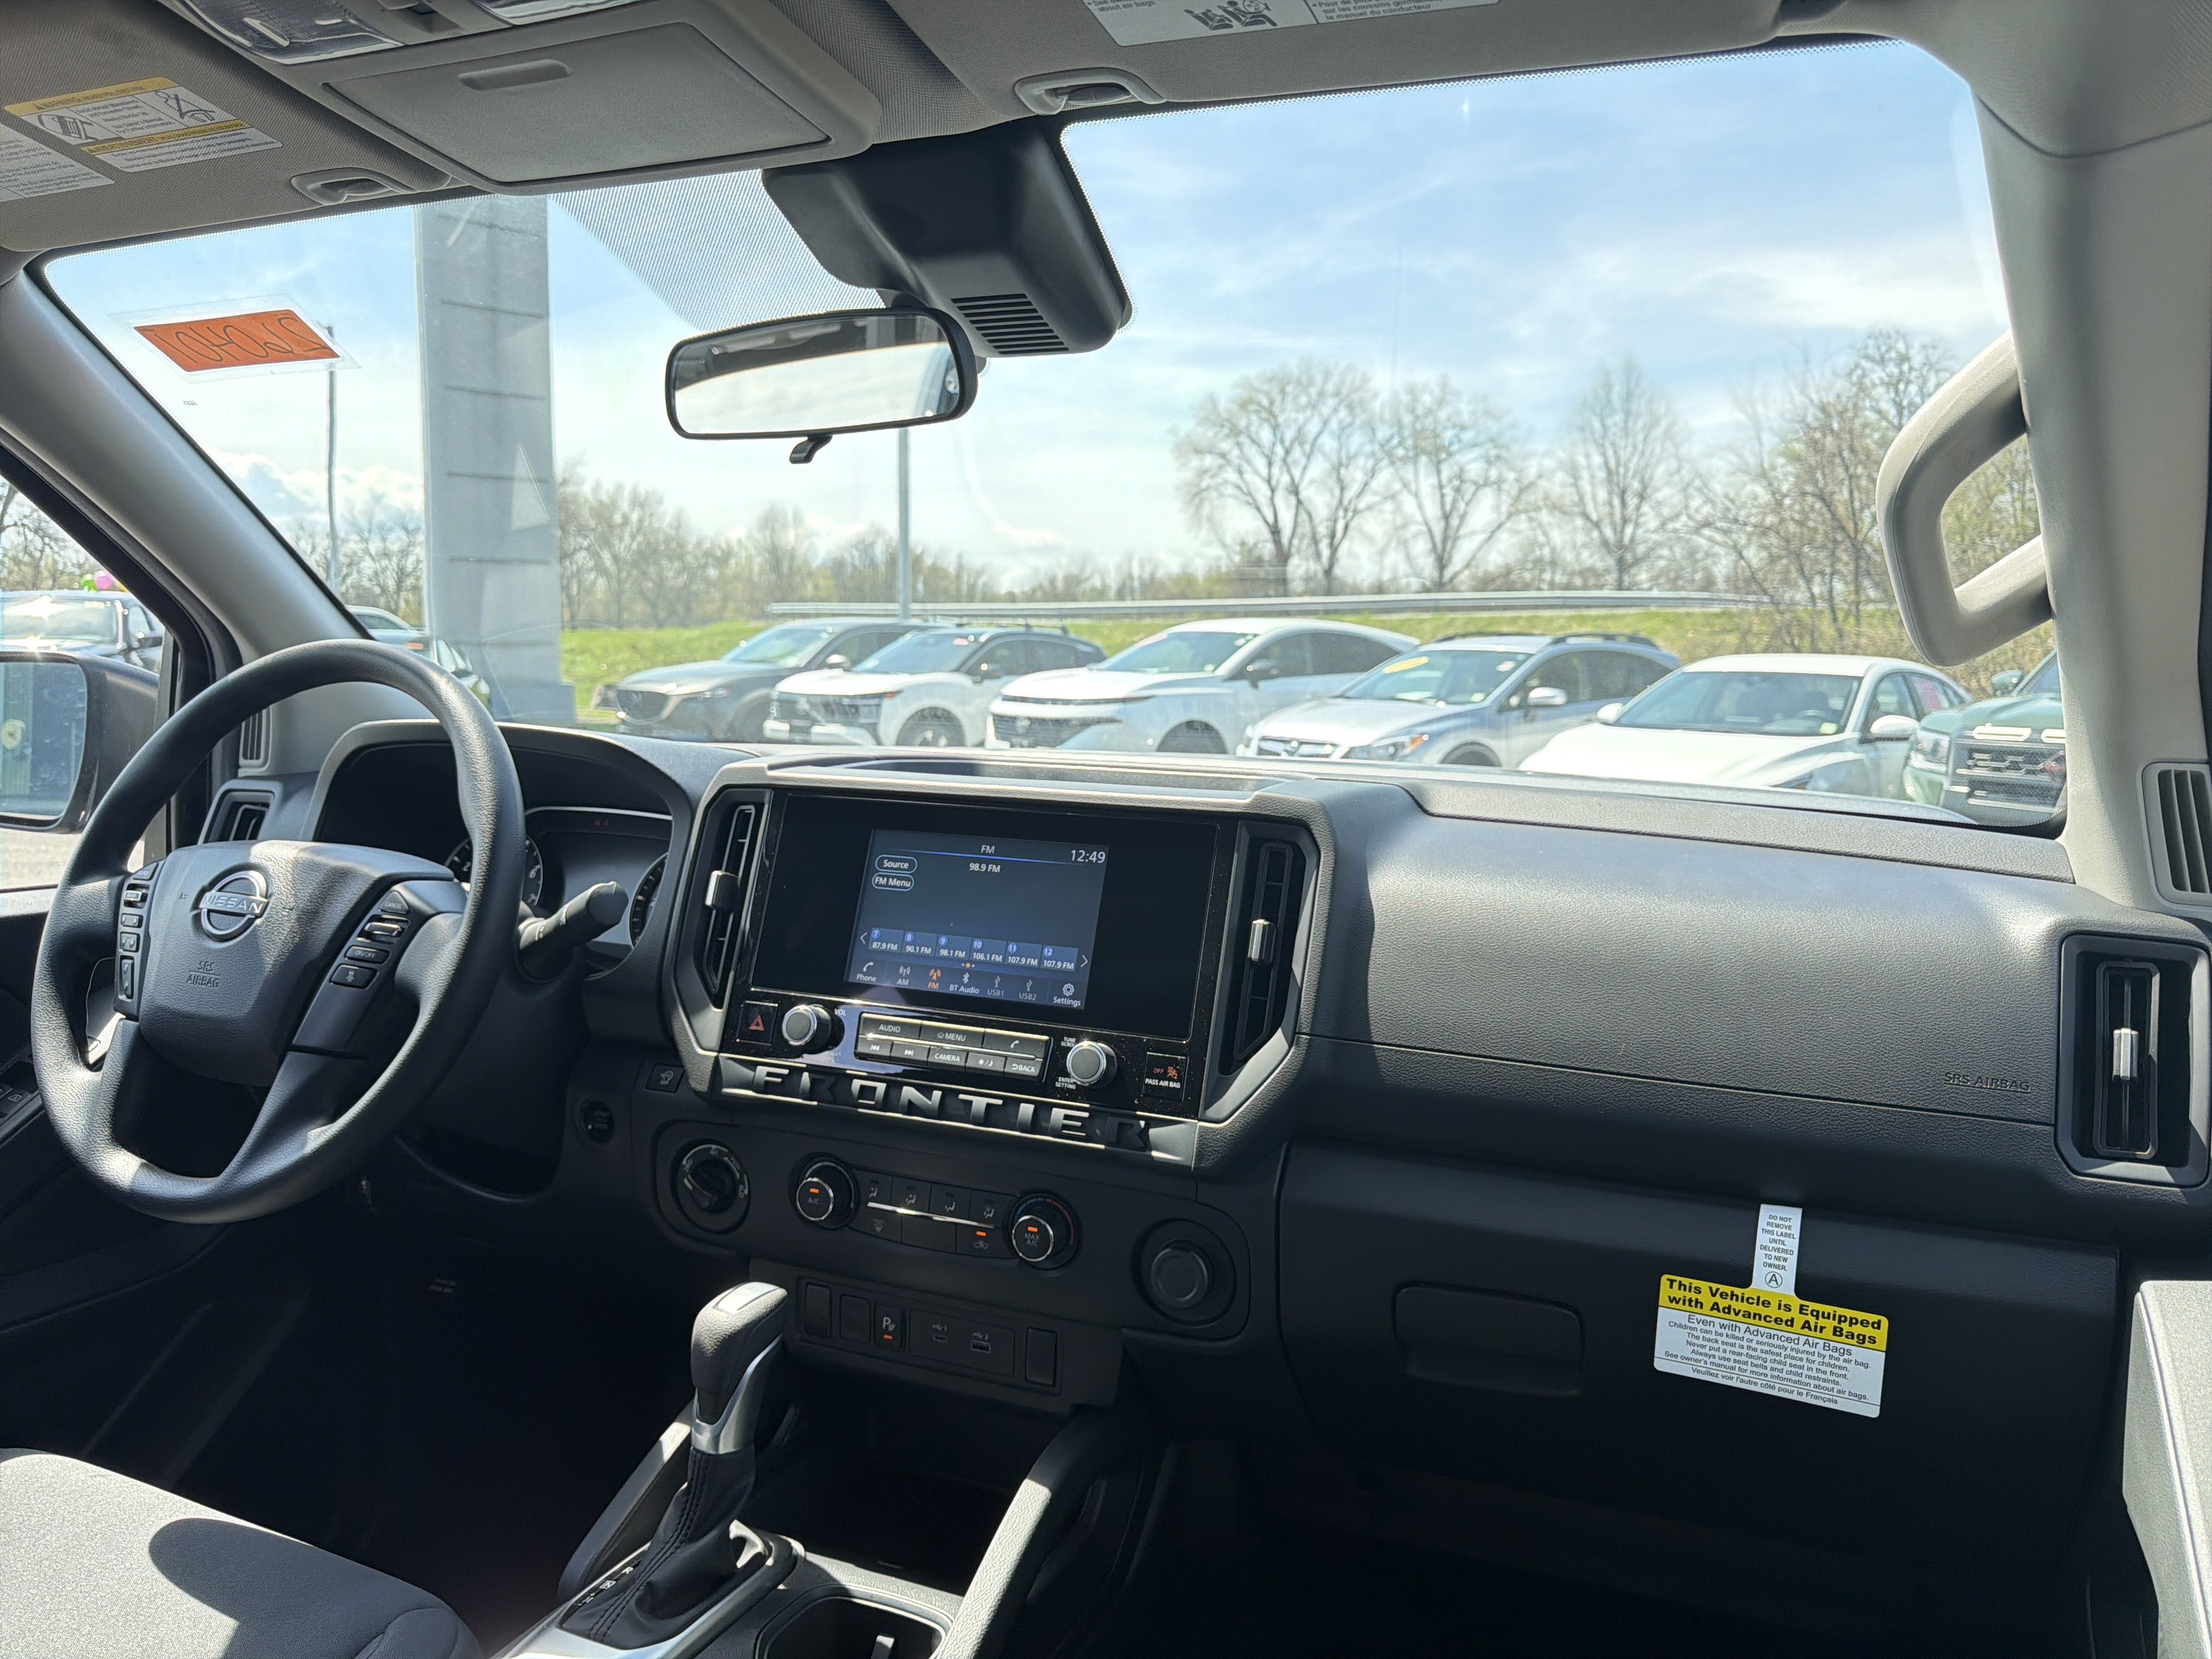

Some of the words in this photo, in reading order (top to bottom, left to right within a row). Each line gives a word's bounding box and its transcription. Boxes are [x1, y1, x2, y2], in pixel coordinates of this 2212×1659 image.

[981, 845, 995, 854] FM
[1070, 849, 1105, 864] 12:49
[883, 859, 909, 869] Source
[969, 862, 986, 871] 98.9
[988, 864, 1001, 873] FM
[888, 878, 911, 887] Menu
[205, 894, 264, 913] NISSAN
[185, 973, 220, 989] AIRBAG
[856, 973, 876, 982] Phone
[960, 985, 979, 994] Audio
[1019, 992, 1037, 1001] USB2
[1053, 996, 1081, 1007] Settings
[878, 1024, 901, 1033] AUDIO
[945, 1032, 967, 1042] MENU
[934, 1053, 960, 1063] CAMERA
[1018, 1064, 1036, 1074] BACK
[1945, 1072, 1970, 1085] SRS
[1975, 1075, 2030, 1091] AIRBAG
[753, 1065, 1149, 1152] FRONTIER
[1767, 1221, 1792, 1231] REMOVE
[1776, 1231, 1796, 1239] LABEL
[1769, 1238, 1786, 1246] UNTIL
[1760, 1244, 1793, 1255] DELIVERED
[1763, 1262, 1787, 1271] OWNER.
[1667, 1278, 1702, 1295] This
[1708, 1285, 1771, 1308] Vehicle
[1778, 1300, 1792, 1312] is
[1798, 1303, 1882, 1330] Equipped
[1667, 1295, 1703, 1310] with
[1709, 1301, 1795, 1328] Advanced
[1800, 1319, 1826, 1334] Air
[1832, 1325, 1877, 1345] Bags
[1688, 1314, 1714, 1328] Even
[1719, 1322, 1740, 1333] with
[1743, 1325, 1800, 1345] Advanced
[1803, 1338, 1819, 1349] Air
[1823, 1342, 1852, 1356] Bags
[1668, 1321, 1697, 1331] Children
[1726, 1333, 1744, 1342] killed
[1756, 1339, 1788, 1352] seriously
[1790, 1346, 1815, 1357] injured
[1817, 1351, 1826, 1360] by
[1854, 1359, 1871, 1369] bag.
[1687, 1332, 1700, 1340] The
[1702, 1335, 1719, 1344] back
[1760, 1348, 1782, 1357] safest
[1784, 1353, 1804, 1362] place
[1818, 1361, 1849, 1372] children.
[1686, 1340, 1707, 1349] Never
[1729, 1350, 1768, 1363] rear-facing
[1830, 1370, 1849, 1380] front.
[1690, 1348, 1716, 1359] Always
[1733, 1358, 1749, 1366] seat
[1751, 1361, 1768, 1370] belts
[1786, 1369, 1803, 1378] child
[1805, 1373, 1842, 1386] restraints.
[1664, 1351, 1678, 1359] See
[1680, 1356, 1708, 1365] owner's
[1710, 1361, 1736, 1371] manual
[1738, 1365, 1748, 1374] for
[1750, 1370, 1768, 1378] more
[1770, 1373, 1811, 1387] information
[1813, 1383, 1834, 1393] about
[1848, 1390, 1869, 1400] bags.
[1691, 1367, 1719, 1378] Veuillez
[1736, 1376, 1758, 1386] l'autre
[1760, 1382, 1776, 1390] côté
[1778, 1386, 1795, 1395] pour
[1805, 1392, 1838, 1404] Français
